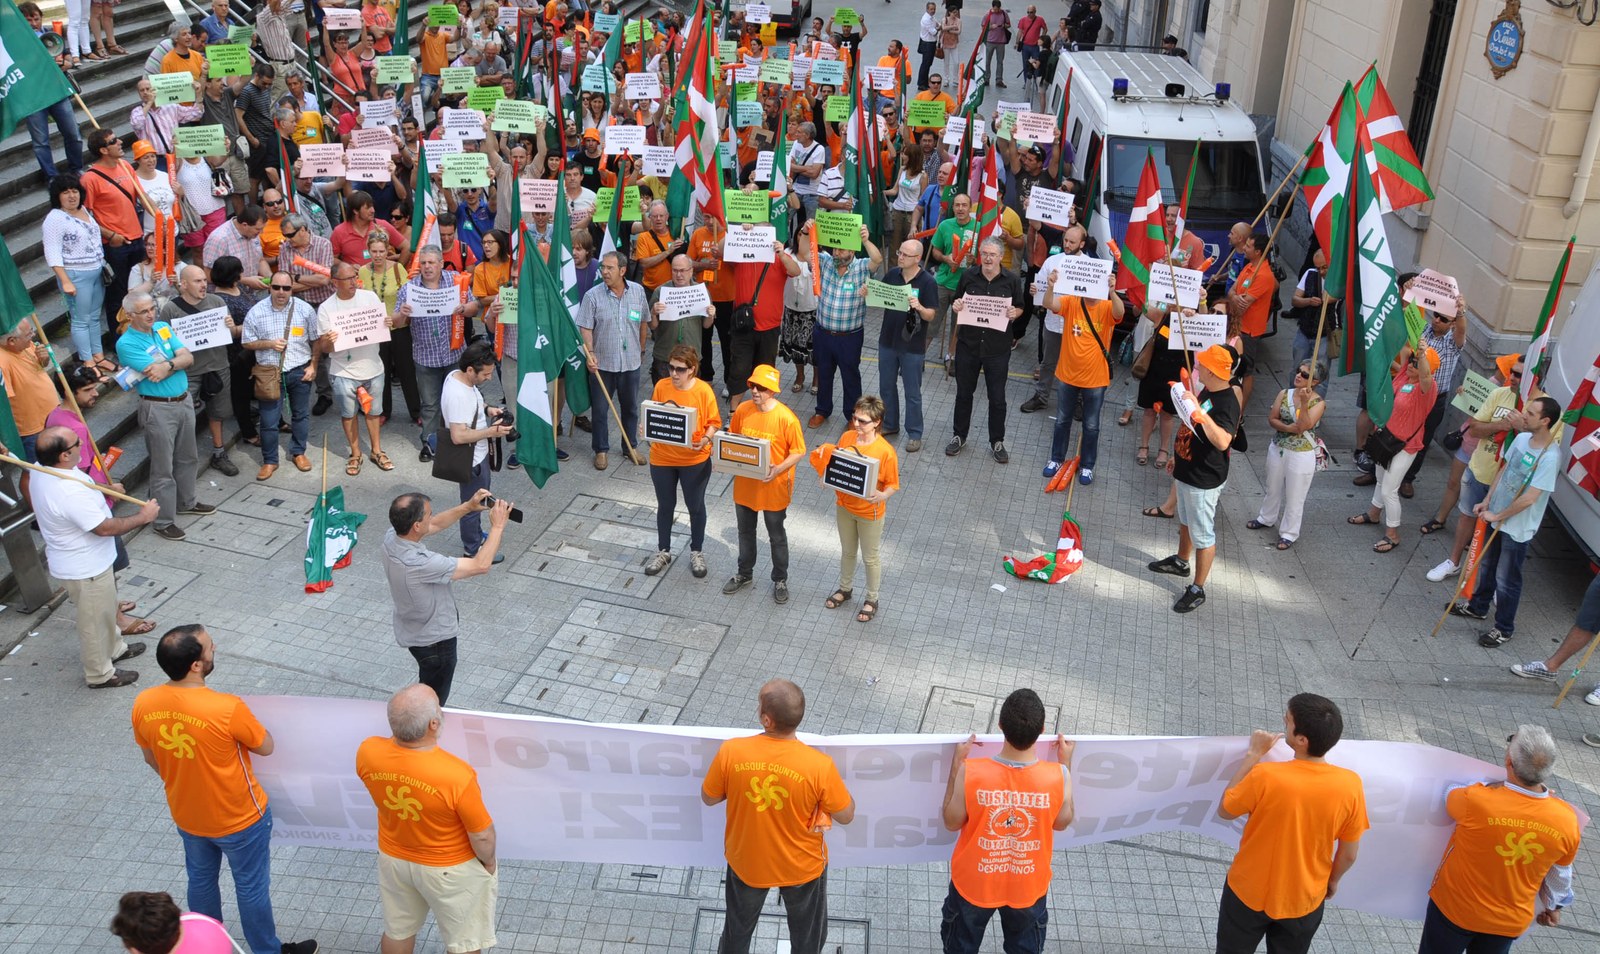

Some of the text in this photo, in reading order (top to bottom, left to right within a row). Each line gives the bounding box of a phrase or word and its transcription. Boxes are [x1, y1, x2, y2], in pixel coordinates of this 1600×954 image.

[1420, 274, 1457, 289] USKALTEL
[1424, 298, 1436, 306] ELA
[182, 325, 208, 334] PERDIDA
[342, 322, 368, 330] PERDIDA
[345, 326, 377, 335] DERECHOS
[185, 328, 217, 339] DERECHOS
[728, 449, 756, 459] Euskaltel
[830, 468, 850, 477] EUSKALTEL
[143, 711, 208, 730] BASQUE COUNTRY
[735, 762, 805, 784] BASQUE COUNTRY
[370, 773, 437, 795] BASQUE COUNTRY
[977, 790, 1050, 809] EUSKALTEL
[1488, 817, 1524, 828] BASQUE
[978, 837, 1040, 852] KUTXABANK
[978, 862, 1035, 874] DESPEDIRNOS
